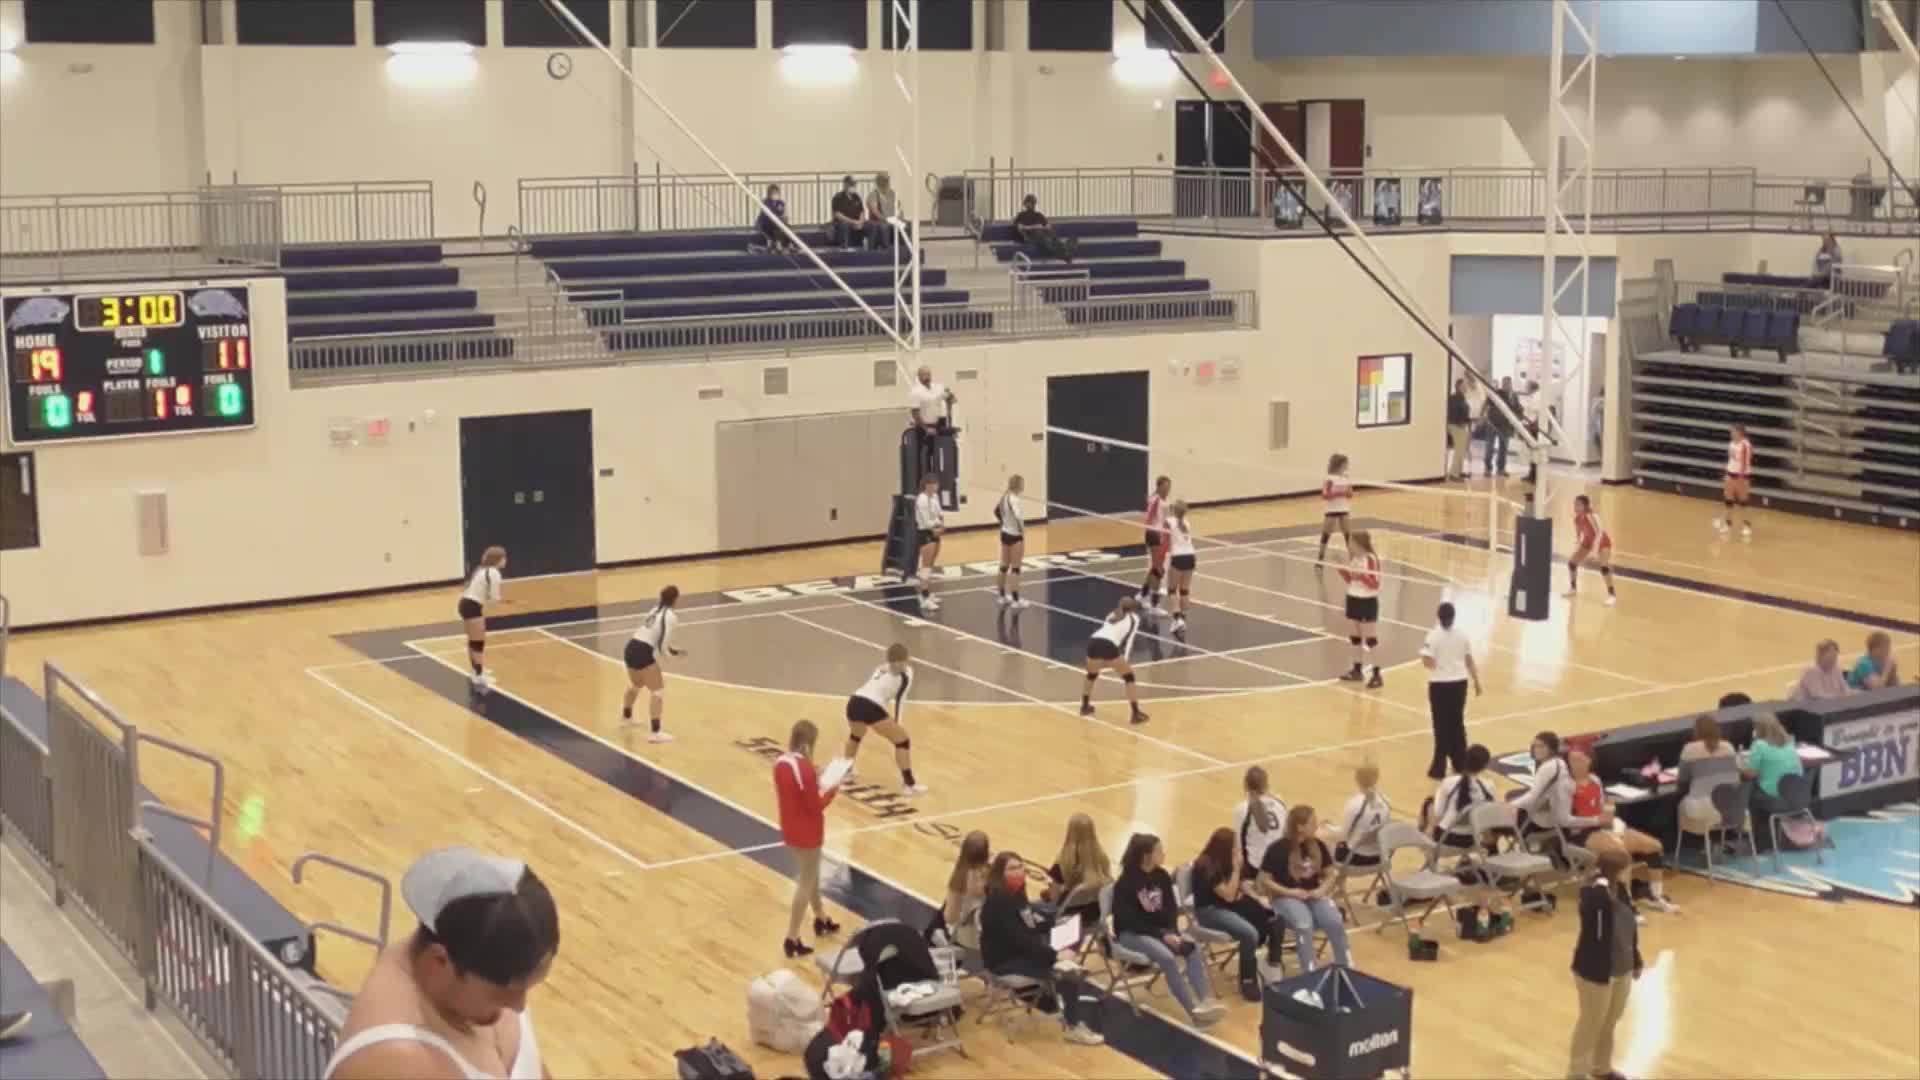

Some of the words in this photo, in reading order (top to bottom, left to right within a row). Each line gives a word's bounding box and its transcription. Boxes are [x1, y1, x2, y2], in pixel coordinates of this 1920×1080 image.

[101, 295, 176, 328] 3:00
[15, 334, 56, 349] HOME
[198, 324, 248, 339] VISITOR
[31, 349, 62, 382] 19
[218, 338, 247, 369] 11
[45, 394, 71, 428] 0
[217, 384, 241, 416] 0
[1838, 736, 1910, 789] BBN
[1349, 1029, 1399, 1057] molten
